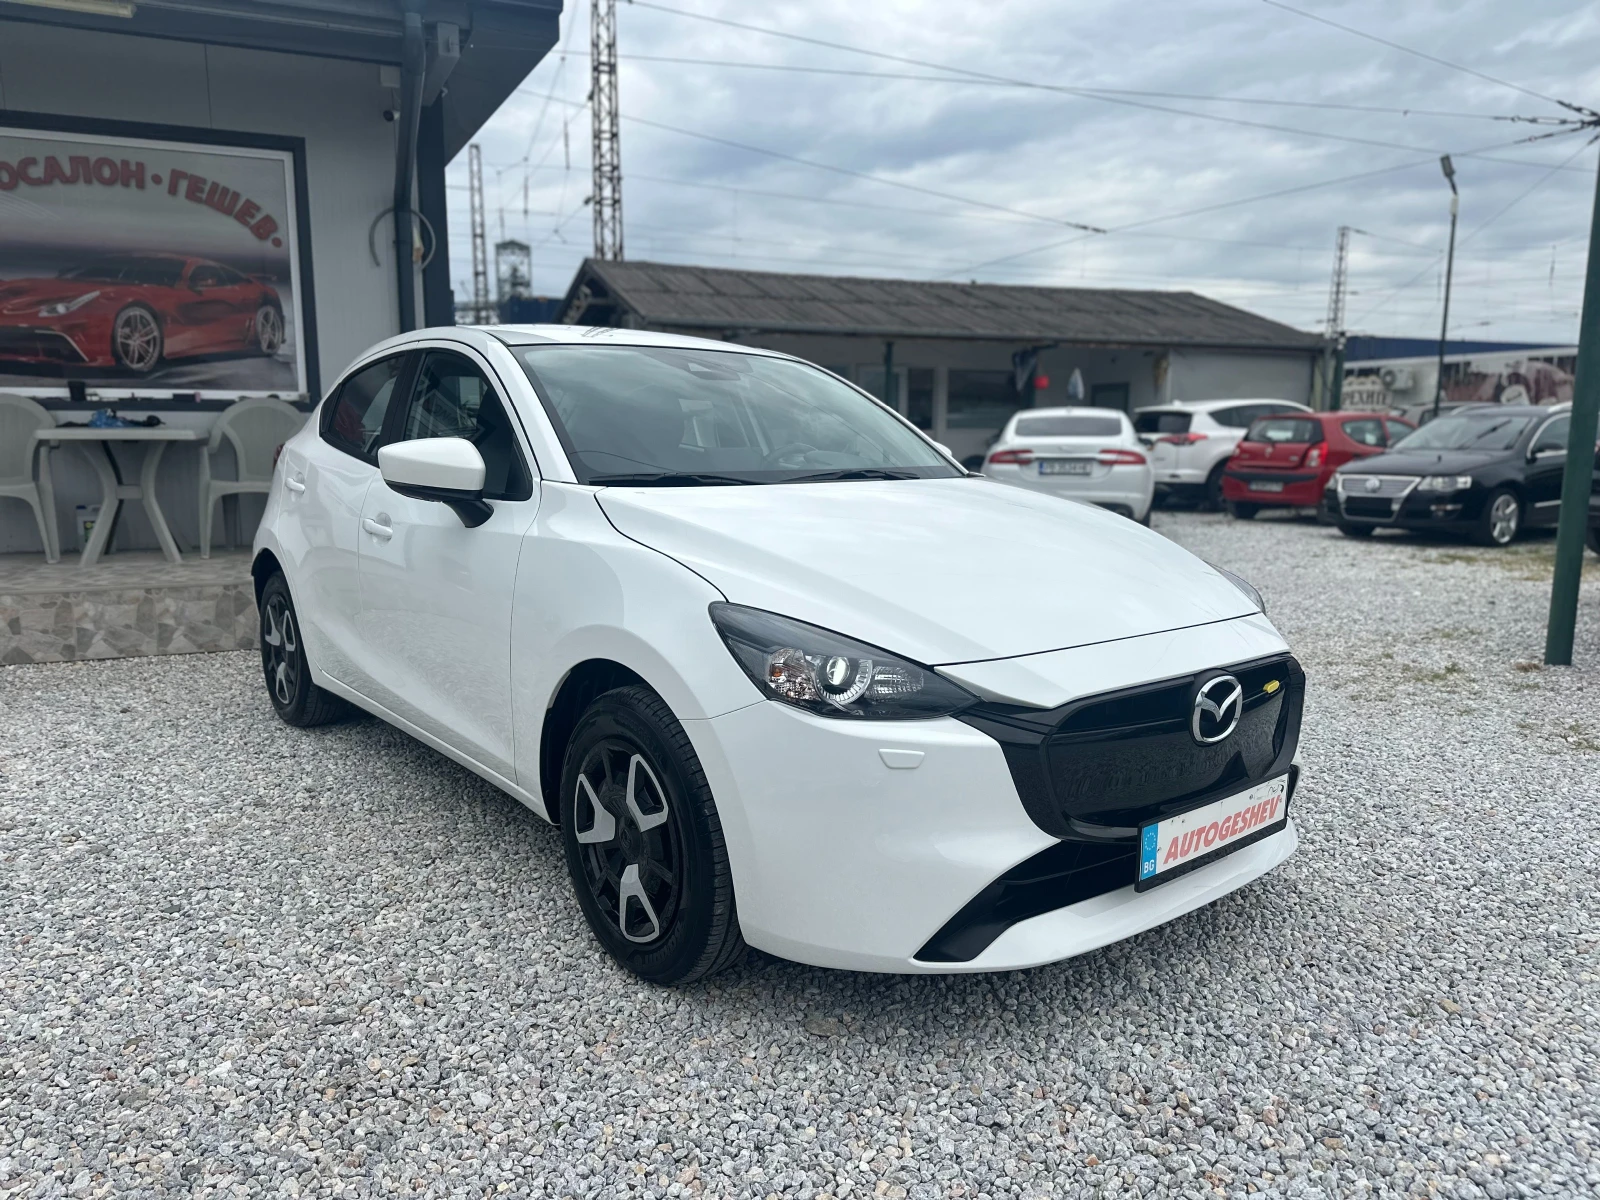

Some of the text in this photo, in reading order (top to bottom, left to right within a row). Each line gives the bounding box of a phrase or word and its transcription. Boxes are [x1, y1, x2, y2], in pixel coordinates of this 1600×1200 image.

[168, 168, 279, 241] ГЕШЕВ
[1143, 795, 1282, 874] BG AUTOGESHEV
